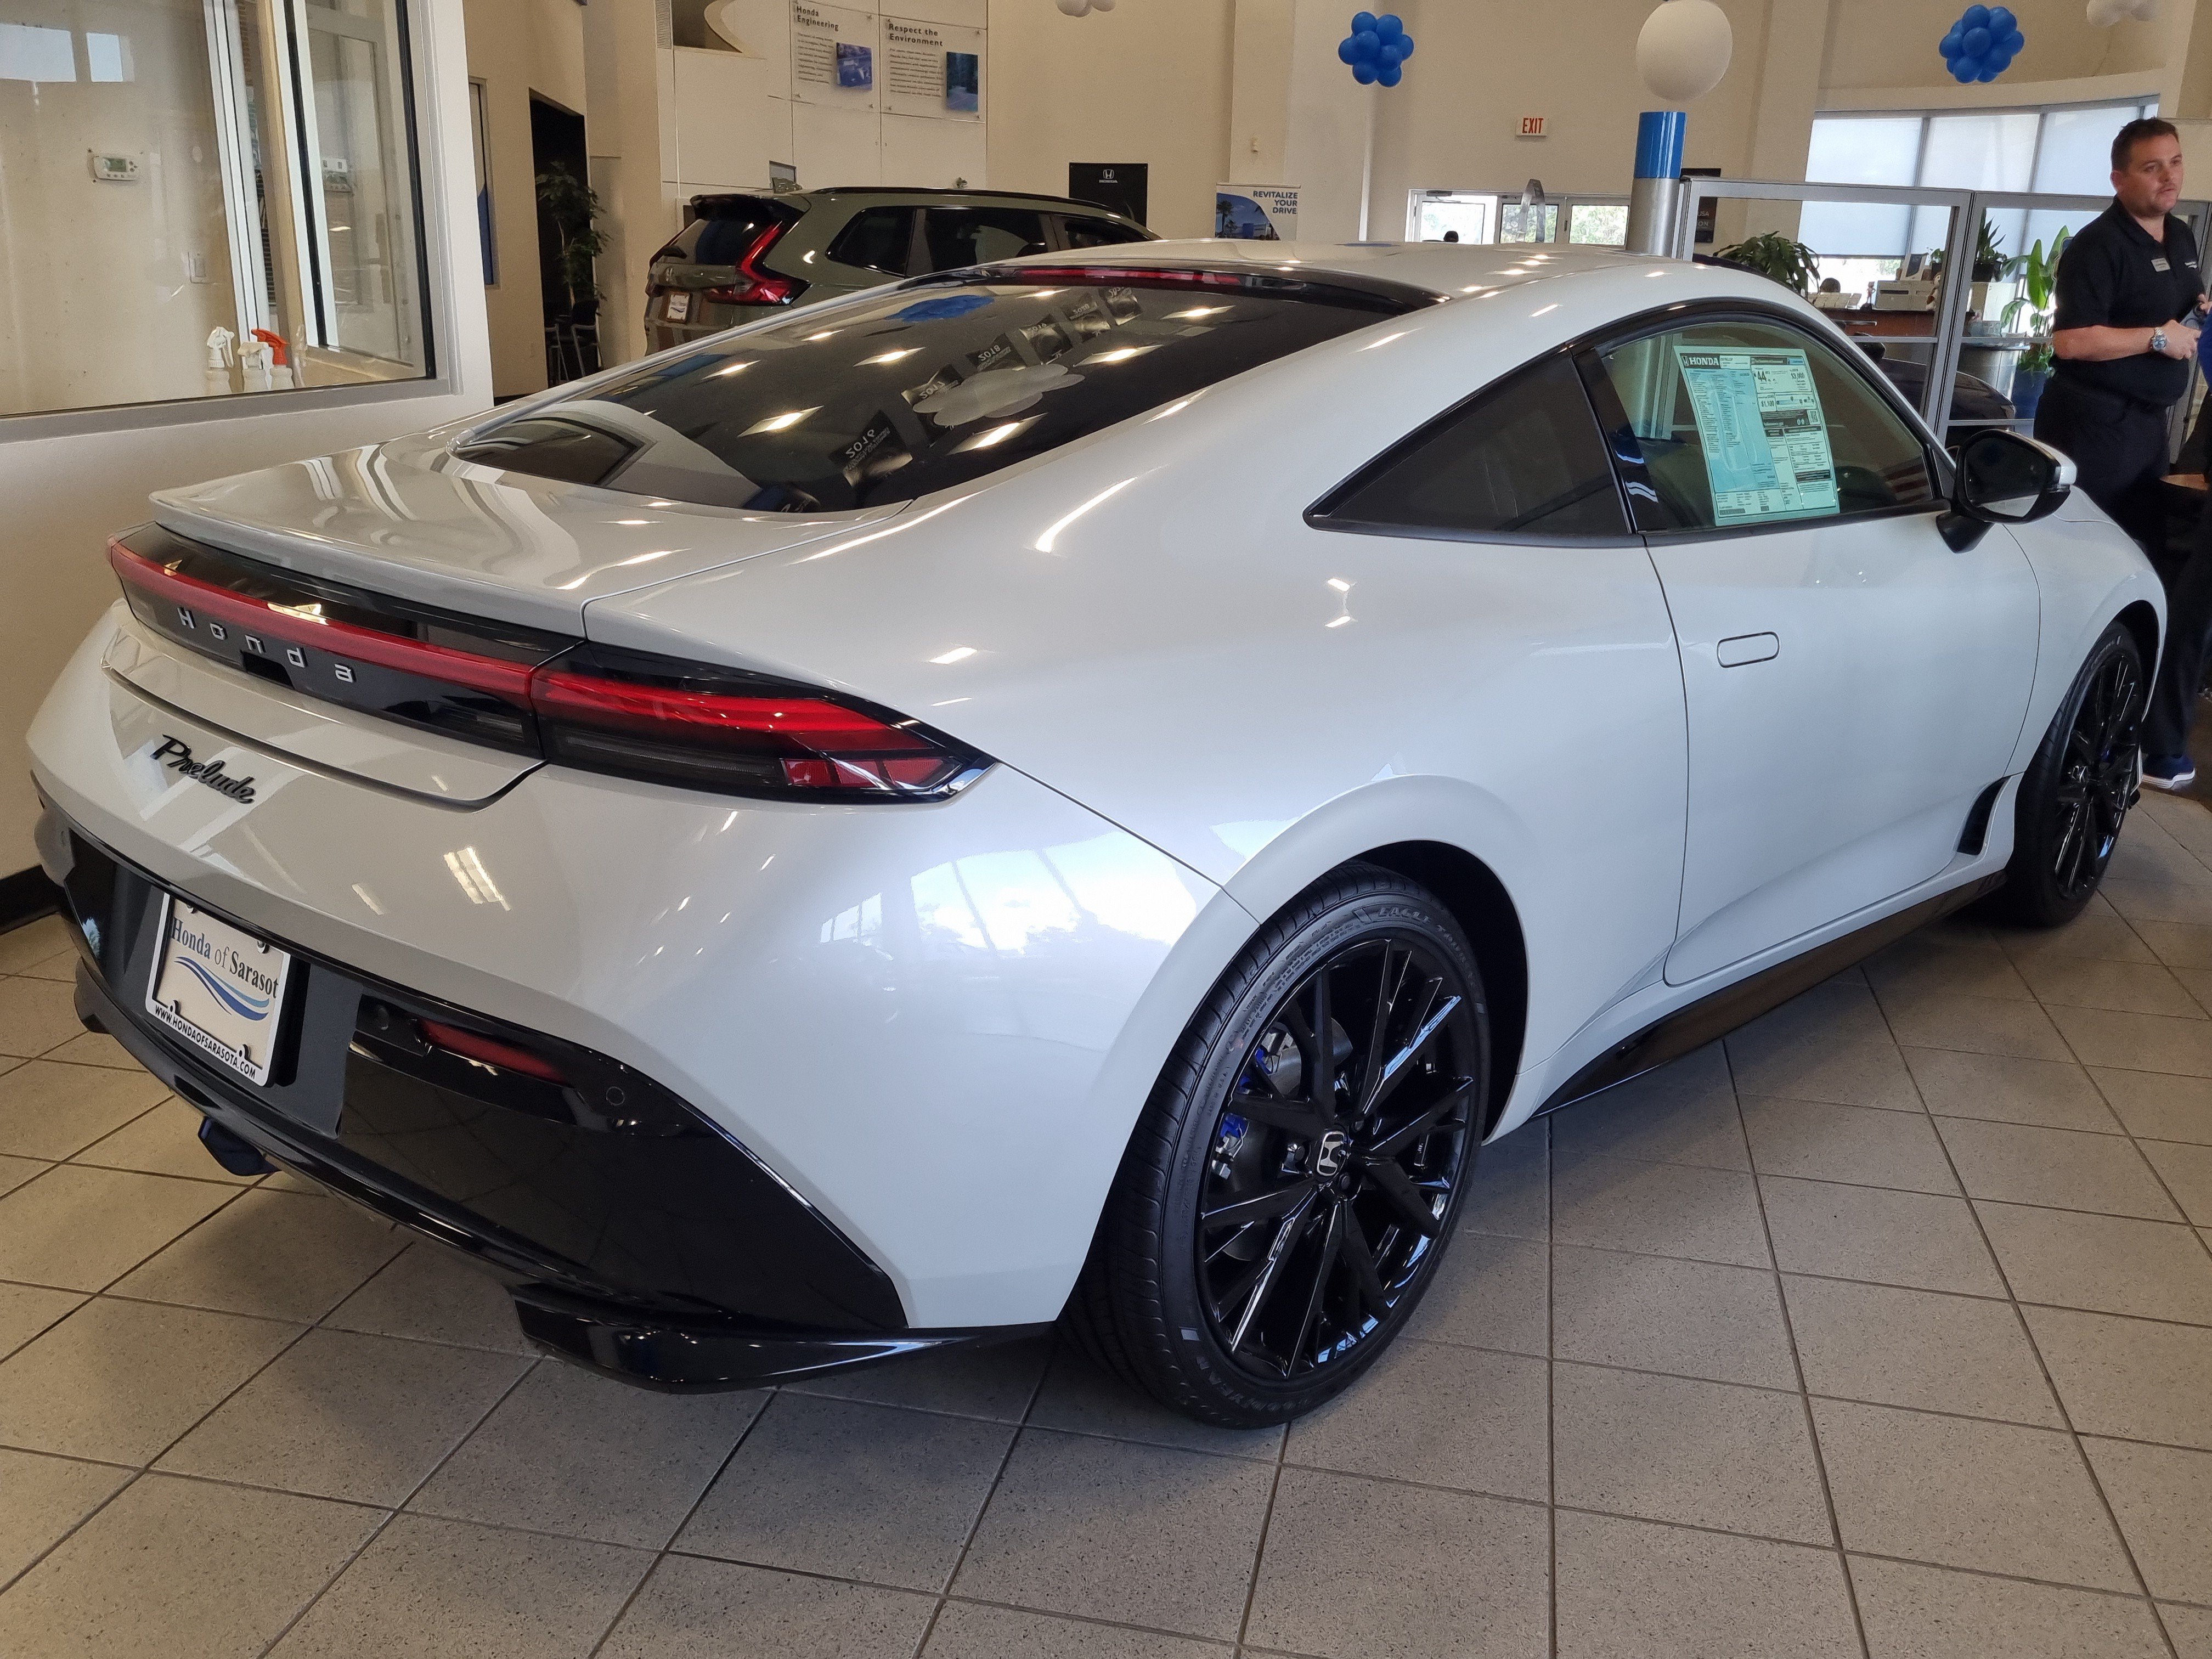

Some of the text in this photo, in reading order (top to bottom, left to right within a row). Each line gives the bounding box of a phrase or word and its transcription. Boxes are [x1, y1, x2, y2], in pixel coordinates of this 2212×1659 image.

[797, 5, 819, 17] Honda
[797, 15, 839, 31] Engineering
[889, 23, 922, 35] Respect
[890, 33, 943, 47] Environment
[1522, 117, 1544, 134] EXIT
[1253, 190, 1298, 199] REVITALIZE
[1689, 357, 1719, 366] HONDA
[1757, 371, 1767, 382] 44
[149, 733, 256, 804] Prelude
[171, 917, 279, 998] Honda of Sarasot
[155, 1005, 255, 1079] WWW.HONDAOFSARASOTA.COM
